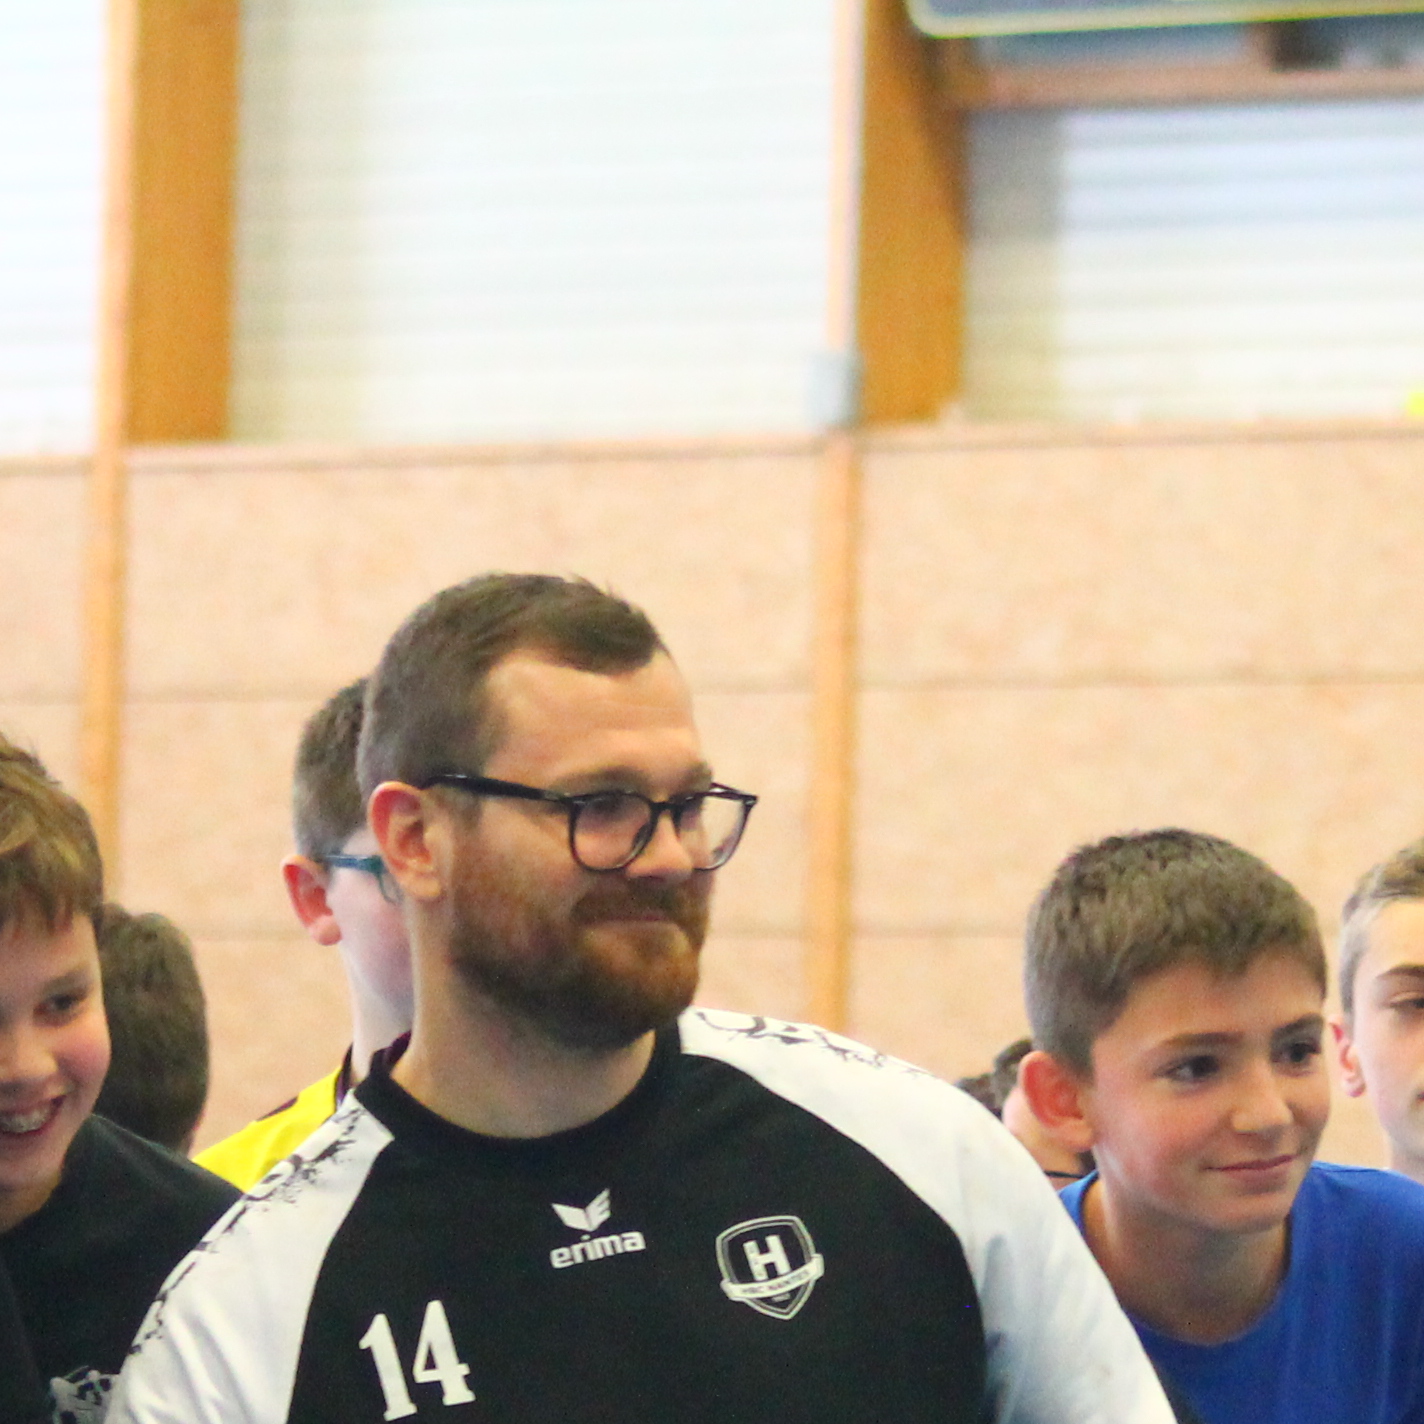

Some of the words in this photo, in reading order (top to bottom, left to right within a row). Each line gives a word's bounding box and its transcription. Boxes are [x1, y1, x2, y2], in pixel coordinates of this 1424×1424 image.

[549, 1230, 646, 1269] erima
[742, 1234, 792, 1282] H
[358, 1299, 476, 1421] 14
